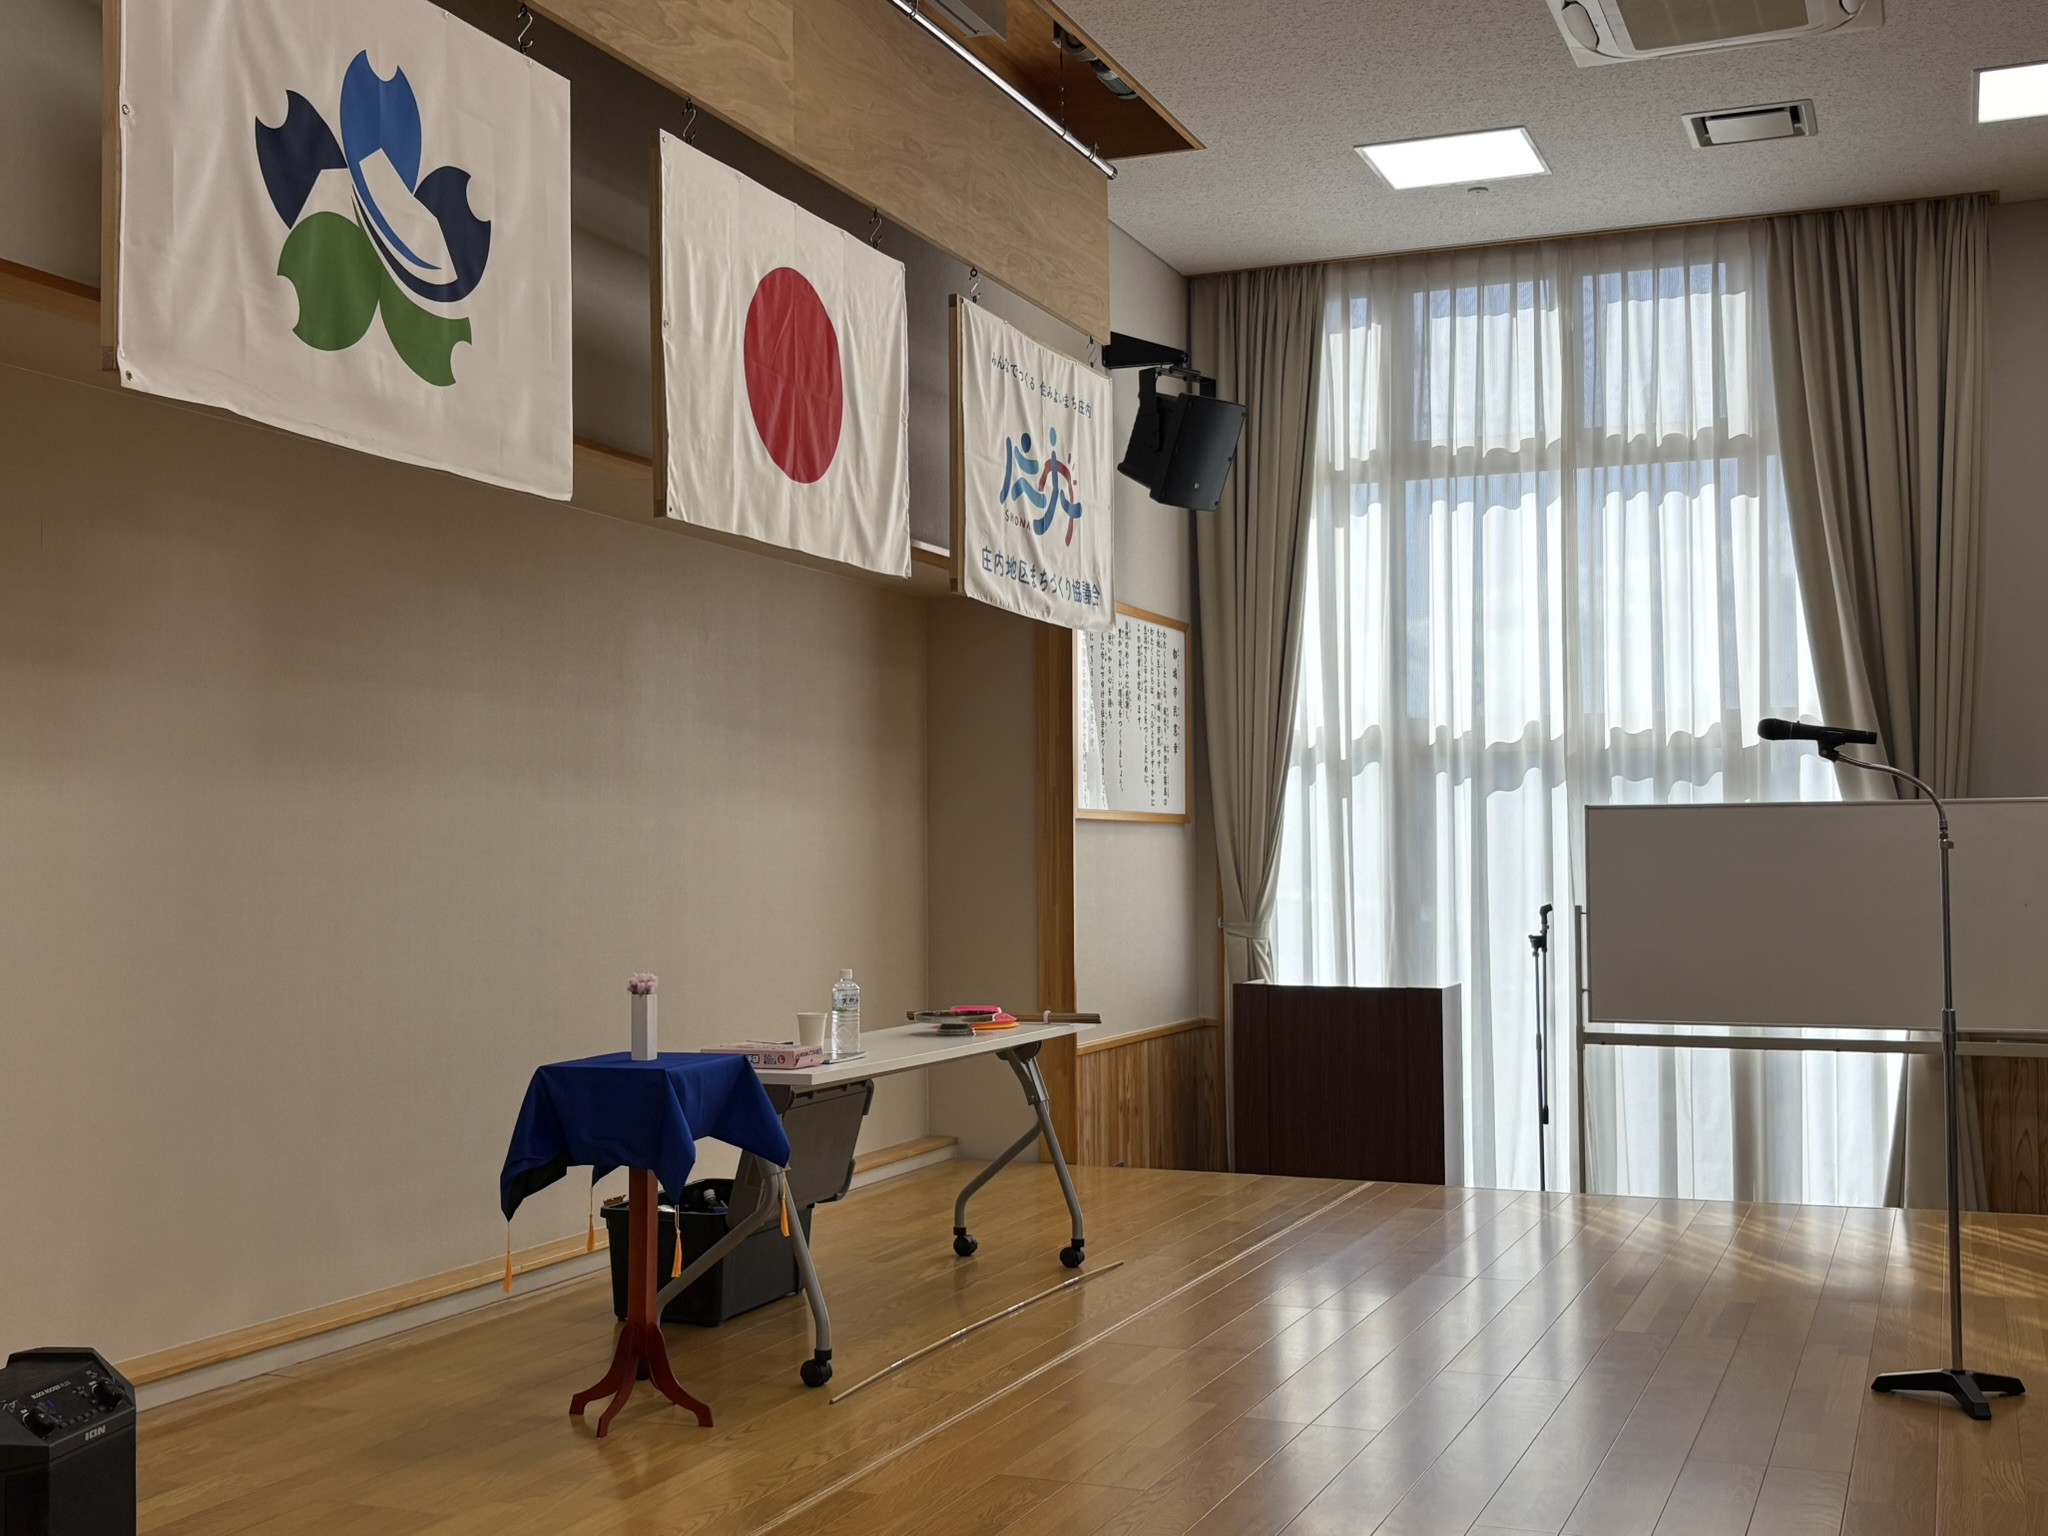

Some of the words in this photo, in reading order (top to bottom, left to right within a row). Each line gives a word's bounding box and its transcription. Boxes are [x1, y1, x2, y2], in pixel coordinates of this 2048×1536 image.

[991, 352, 1035, 391] みんなでつくる
[1039, 380, 1093, 419] 住みよいまち庄内
[981, 545, 1101, 607] 庄内地区まちづくり協議会
[84, 1424, 106, 1442] ION
